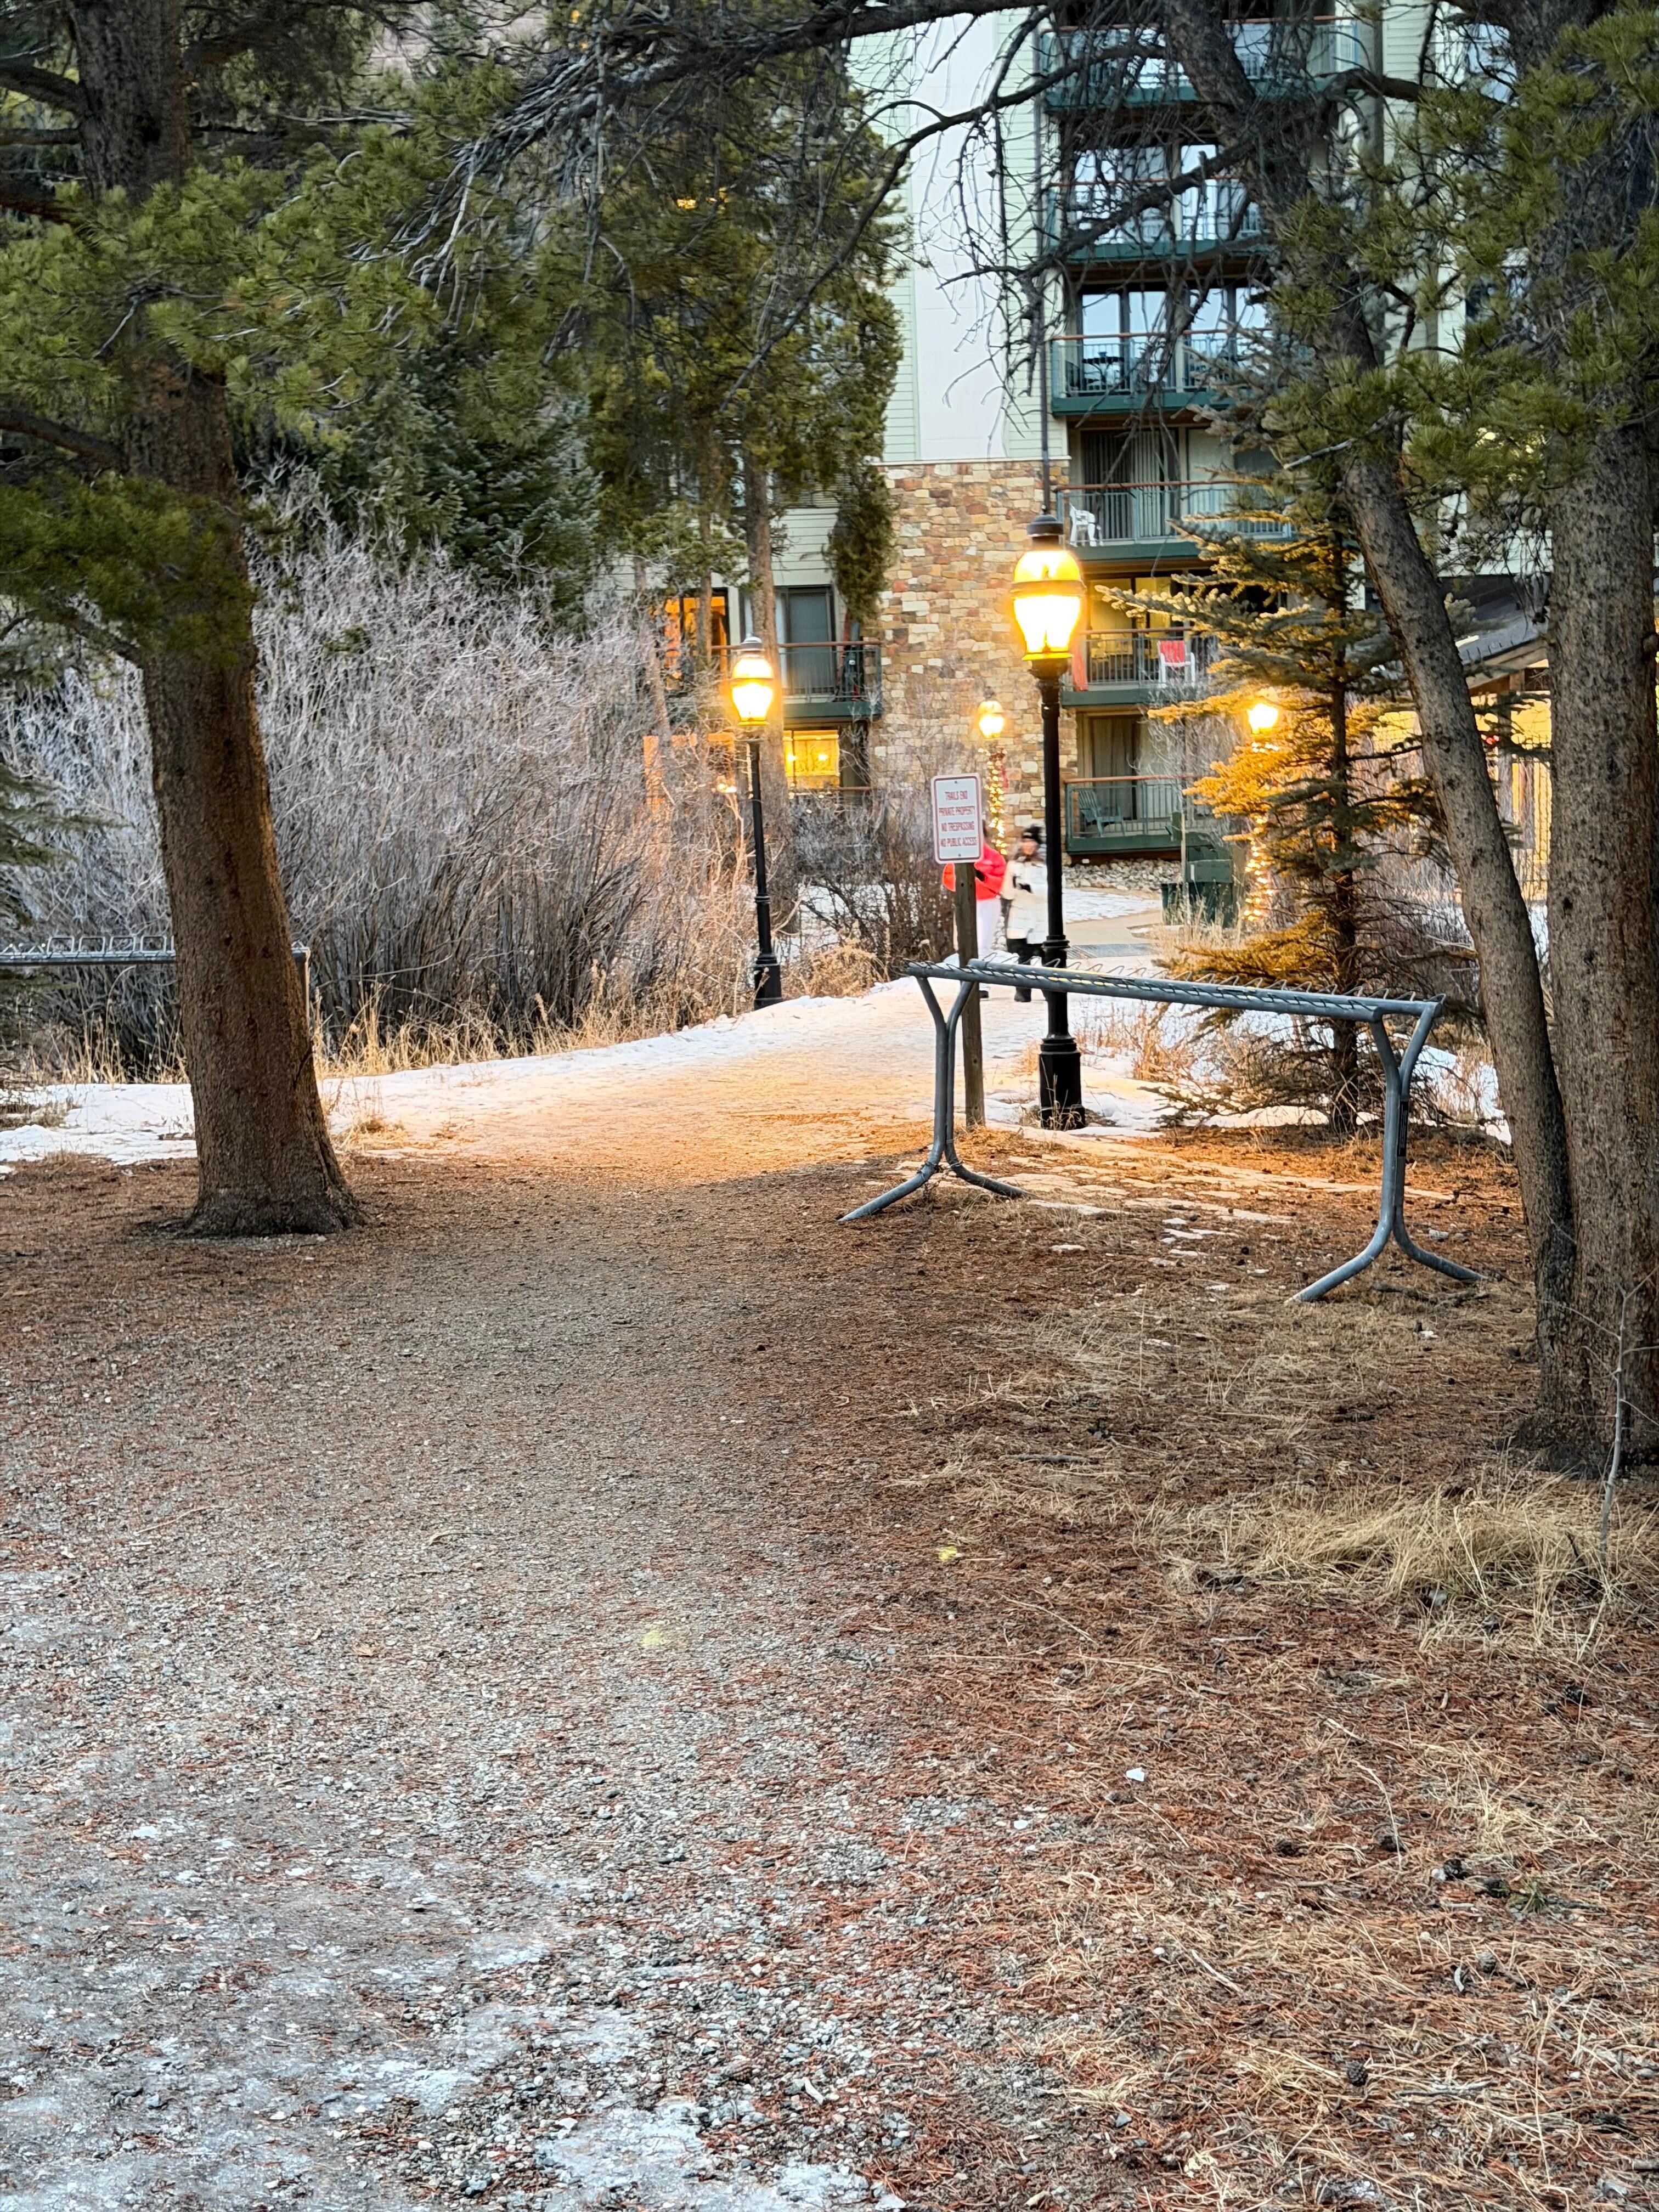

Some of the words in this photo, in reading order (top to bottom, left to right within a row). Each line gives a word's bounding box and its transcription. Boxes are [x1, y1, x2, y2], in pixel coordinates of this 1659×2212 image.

[939, 807, 955, 816] PRIVATE
[955, 805, 975, 815] PROPERTY
[941, 823, 947, 832] NO
[948, 821, 975, 831] TRESPASSING
[940, 838, 946, 847] NO
[947, 837, 961, 847] PUBLIC
[962, 837, 977, 846] ACCESS
